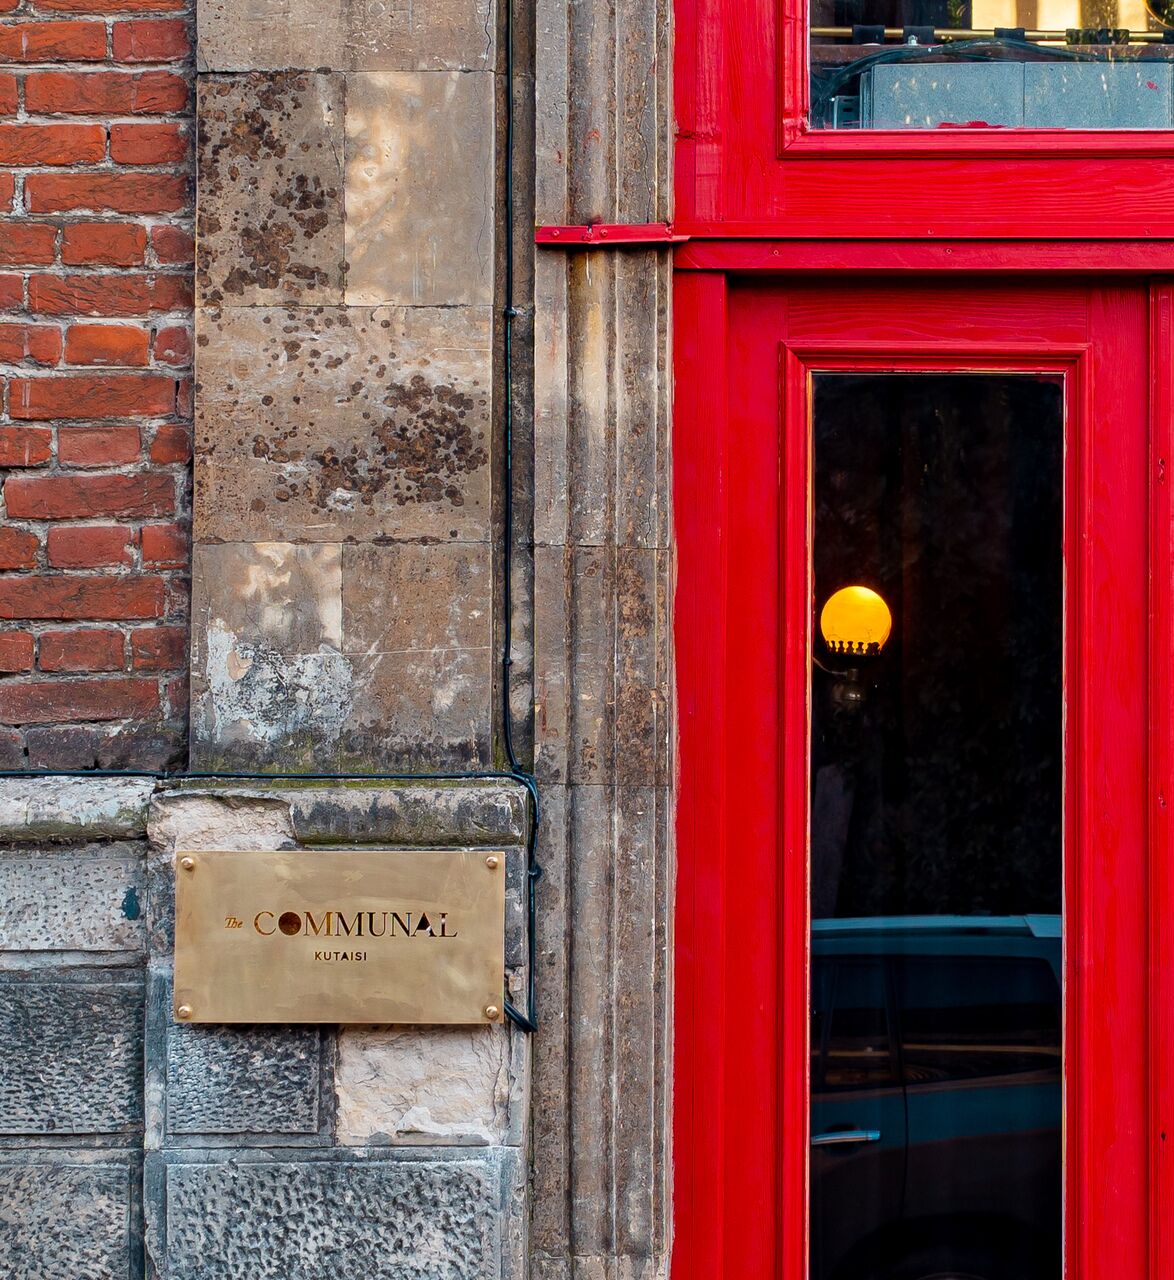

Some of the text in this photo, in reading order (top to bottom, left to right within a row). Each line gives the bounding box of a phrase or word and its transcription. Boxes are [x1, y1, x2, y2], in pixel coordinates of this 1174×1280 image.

[224, 911, 458, 938] The COMMUNAL
[314, 951, 367, 961] KUTAISI
